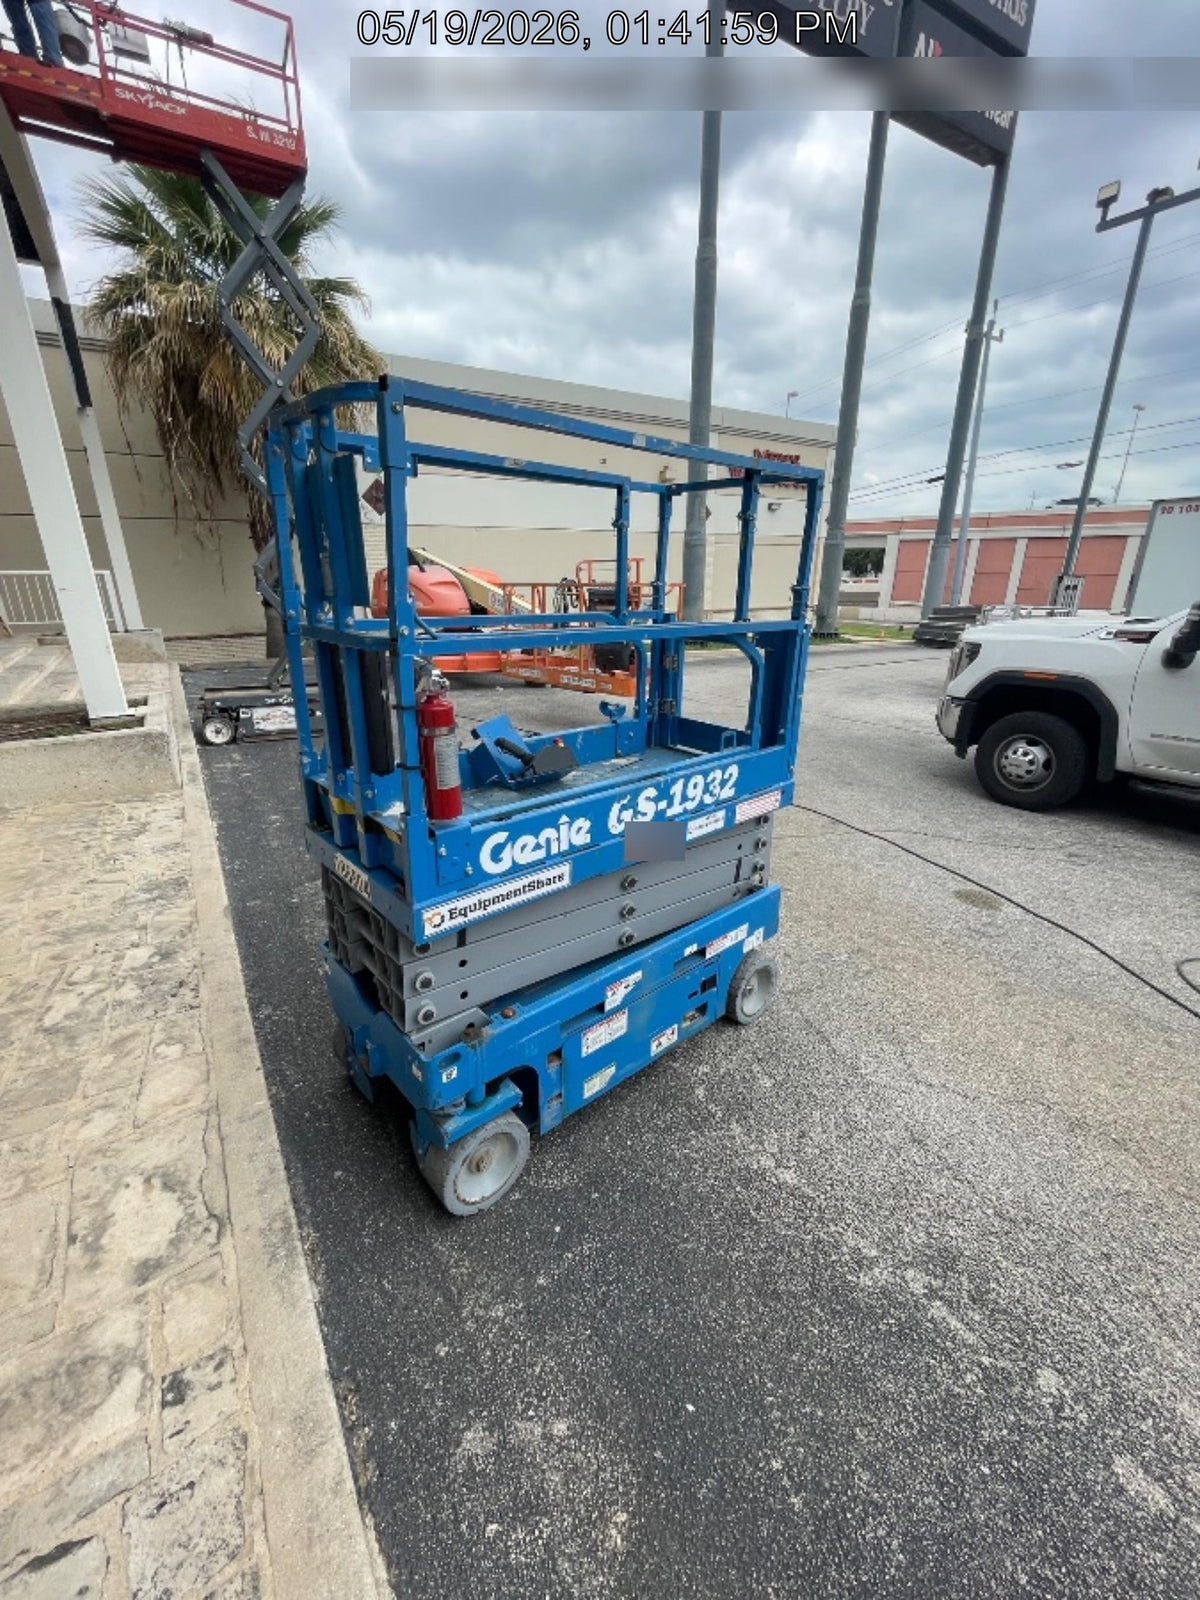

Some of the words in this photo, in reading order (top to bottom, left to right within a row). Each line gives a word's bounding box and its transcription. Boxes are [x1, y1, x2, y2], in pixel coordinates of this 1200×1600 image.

[114, 87, 187, 115] SKYJACK
[479, 813, 592, 875] Genie
[607, 763, 739, 835] GS-1932
[447, 872, 567, 922] EquipmentShare
